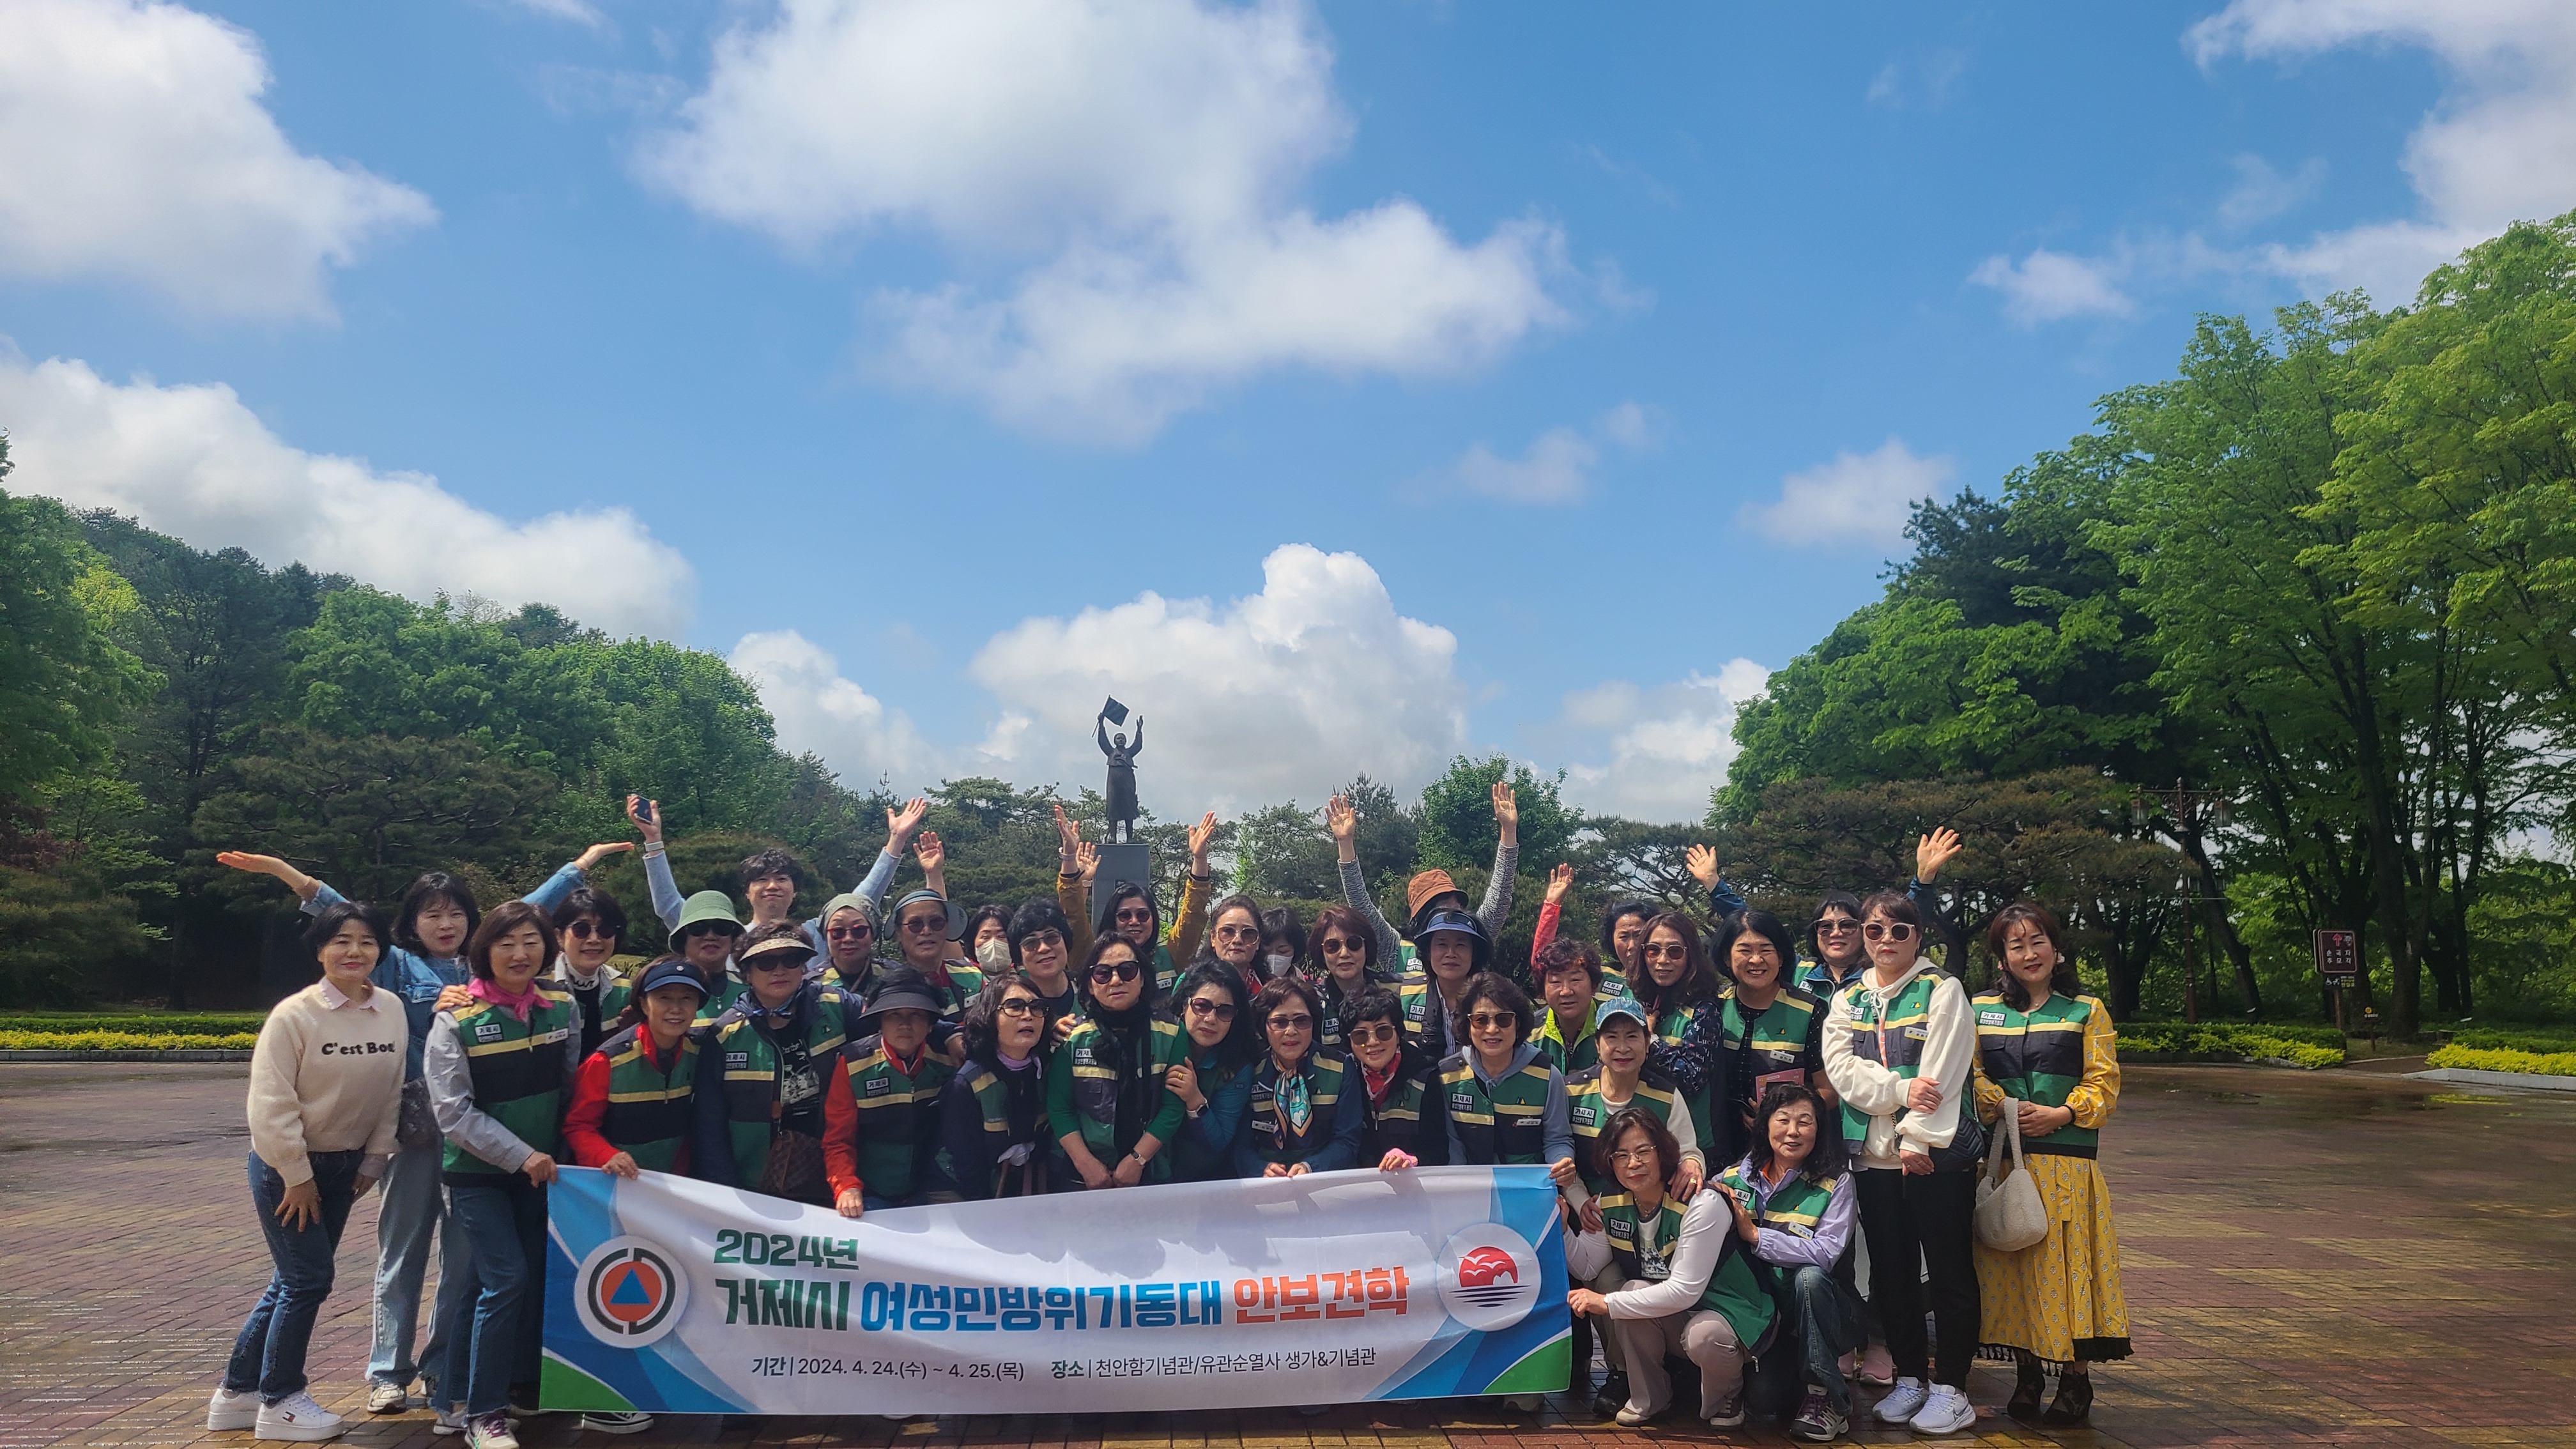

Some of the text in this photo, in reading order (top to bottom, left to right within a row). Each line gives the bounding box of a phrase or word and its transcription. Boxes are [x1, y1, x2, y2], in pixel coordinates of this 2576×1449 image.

[321, 1041, 364, 1055] C'est
[1575, 1108, 1593, 1117] 거제시
[1612, 1220, 1629, 1230] 거제시
[714, 1229, 859, 1270] 2024년
[715, 1266, 1410, 1331] 거제시 여성민방위기동대 안보견학
[752, 1356, 786, 1376] 기간
[798, 1358, 847, 1374] 2024.
[852, 1360, 868, 1374] 4.
[949, 1363, 964, 1377] 4.
[969, 1362, 1024, 1382] 25.(목)
[1051, 1347, 1376, 1379] 장소 천안함기념관/유관순열사 생가&기념관
